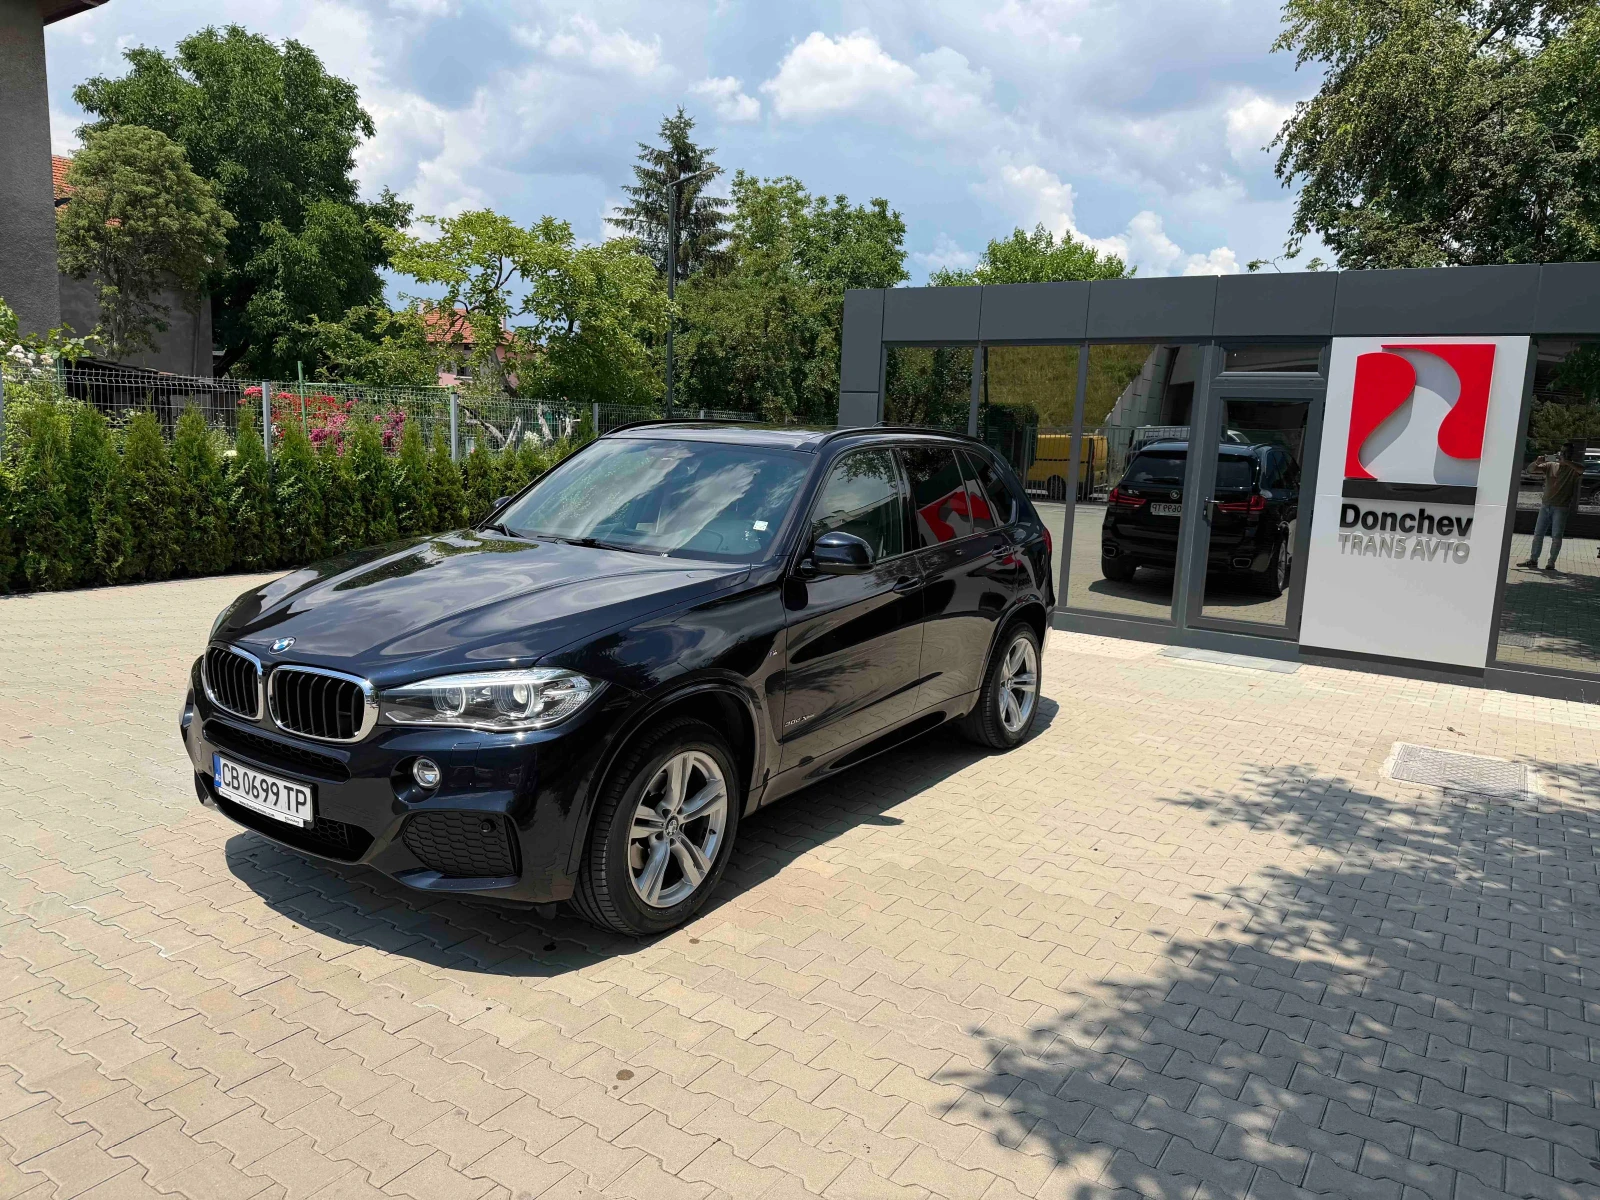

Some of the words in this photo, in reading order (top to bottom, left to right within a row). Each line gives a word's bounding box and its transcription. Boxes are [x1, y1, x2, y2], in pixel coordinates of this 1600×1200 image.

[1339, 503, 1473, 537] Donchev
[1338, 532, 1407, 559] TRANS
[1410, 537, 1471, 565] AVTO
[222, 762, 240, 791] CB
[242, 771, 280, 806] 0699
[283, 784, 307, 813] TP
